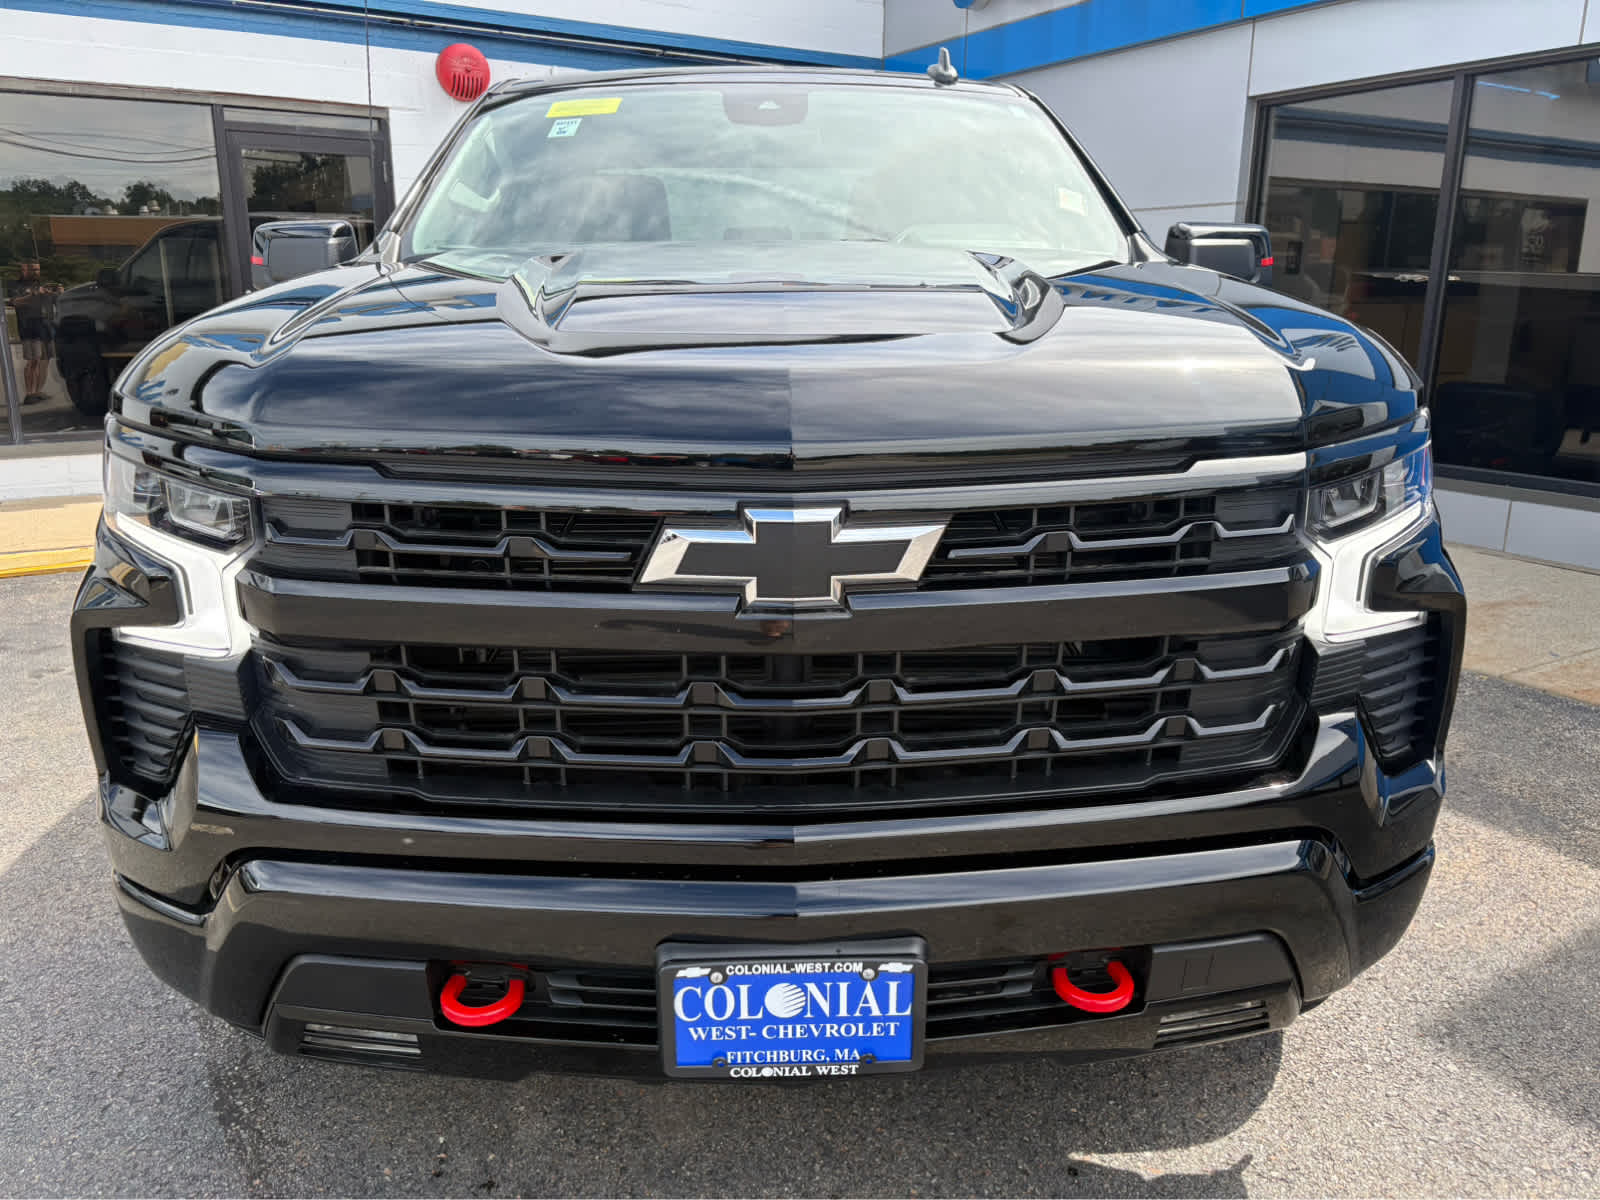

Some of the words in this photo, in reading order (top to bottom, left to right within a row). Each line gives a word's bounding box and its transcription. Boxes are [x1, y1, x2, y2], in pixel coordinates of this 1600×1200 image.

[726, 962, 863, 976] COLONIAL-WEST.COM
[674, 981, 912, 1022] COLONIAL
[762, 1022, 900, 1039] CHEVROLET
[727, 1049, 830, 1064] FITCHBURG,
[834, 1048, 861, 1061] MA
[730, 1065, 811, 1078] COLONIAL
[816, 1064, 860, 1076] WEST
